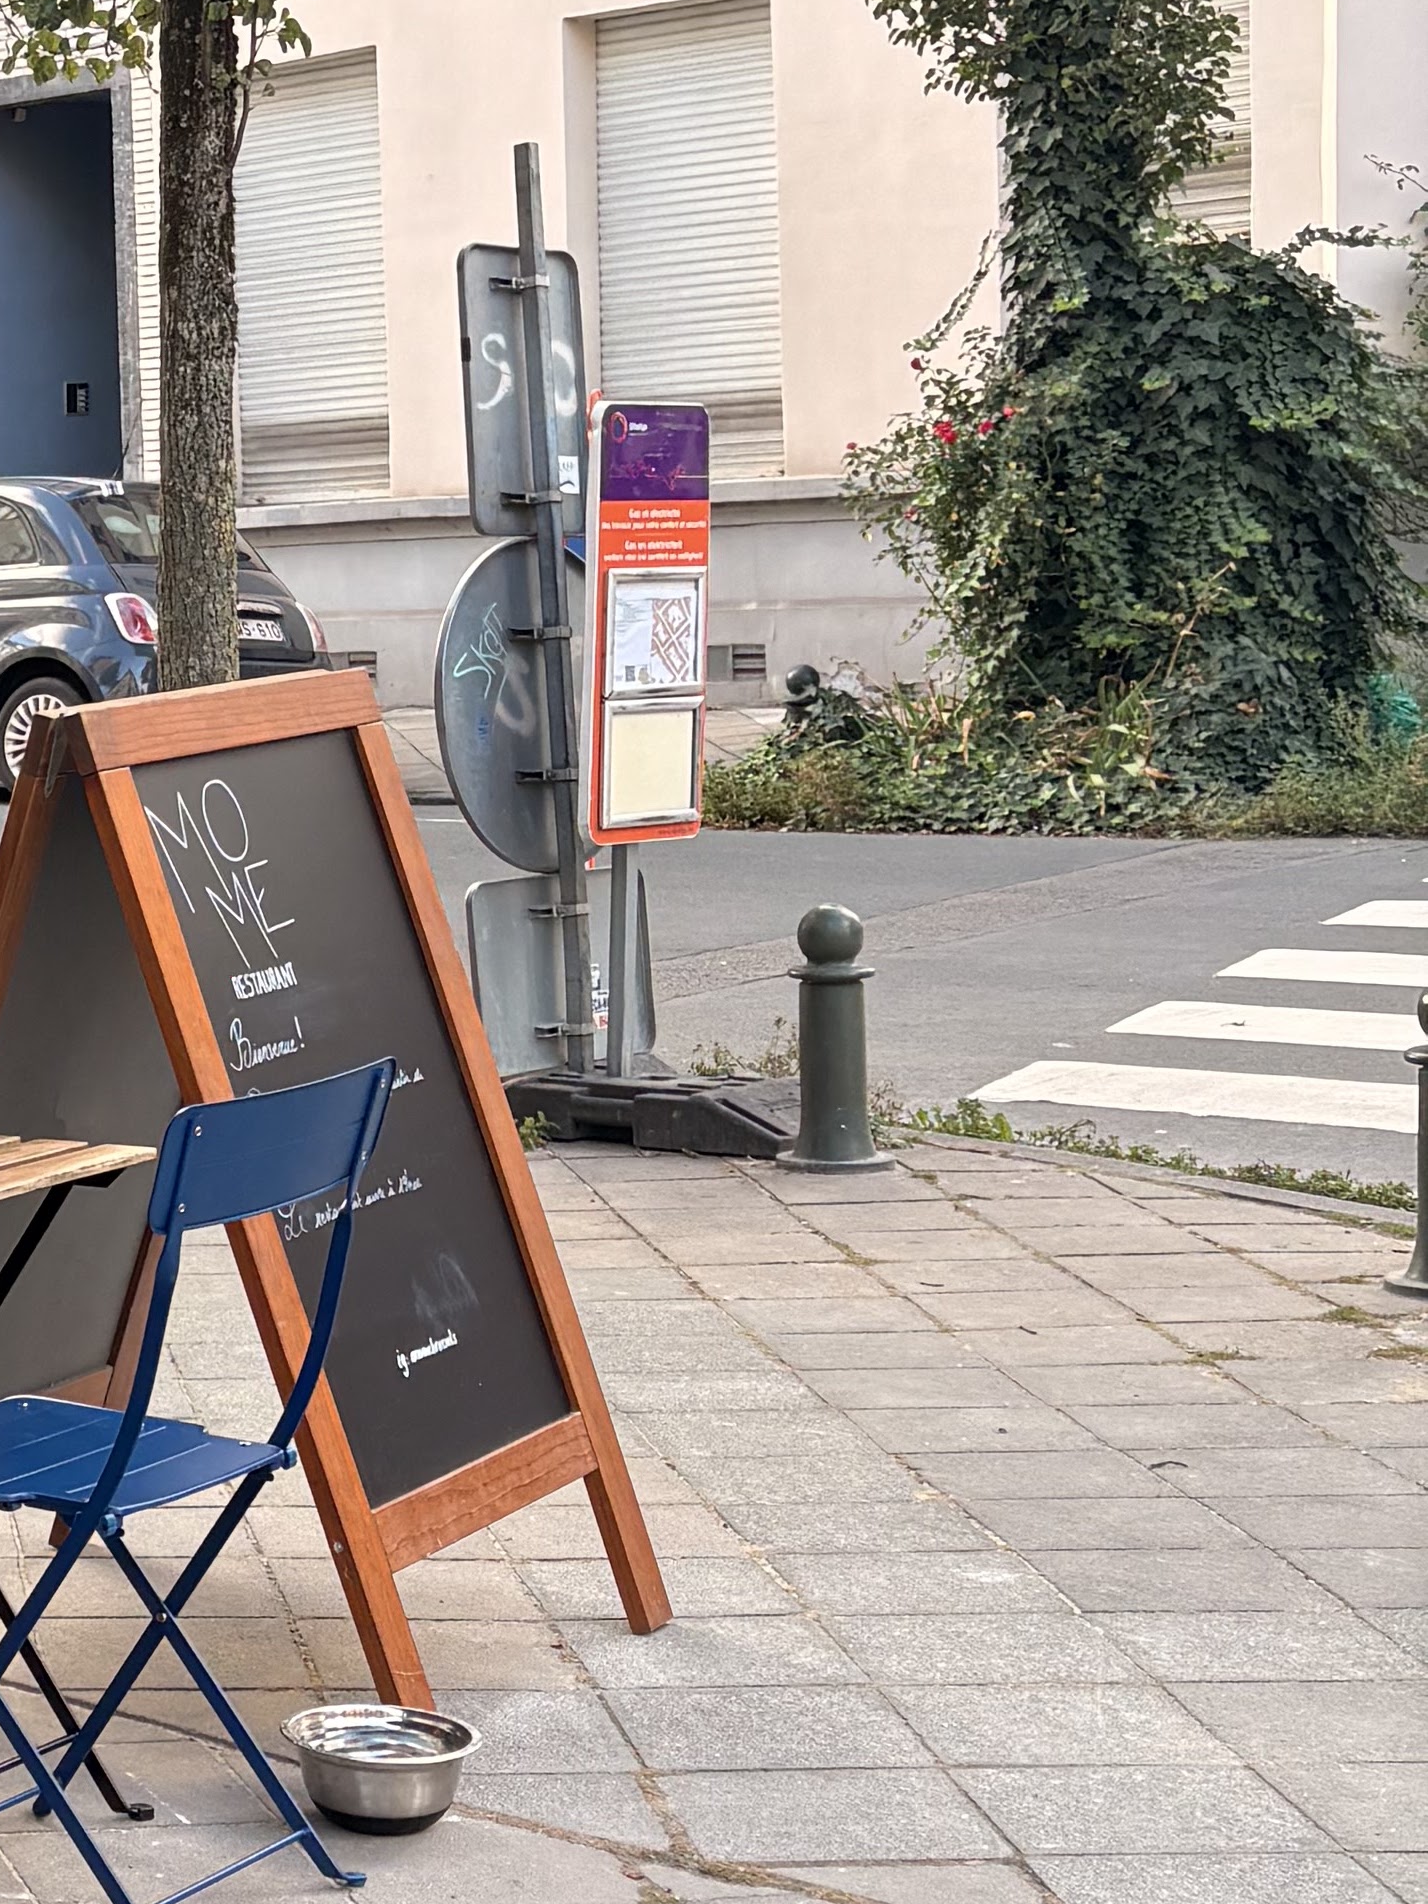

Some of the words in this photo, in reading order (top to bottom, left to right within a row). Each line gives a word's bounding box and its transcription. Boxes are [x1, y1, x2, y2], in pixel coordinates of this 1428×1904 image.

[144, 779, 249, 913] MO
[205, 859, 296, 969] ME
[231, 962, 298, 999] RESTAURANT
